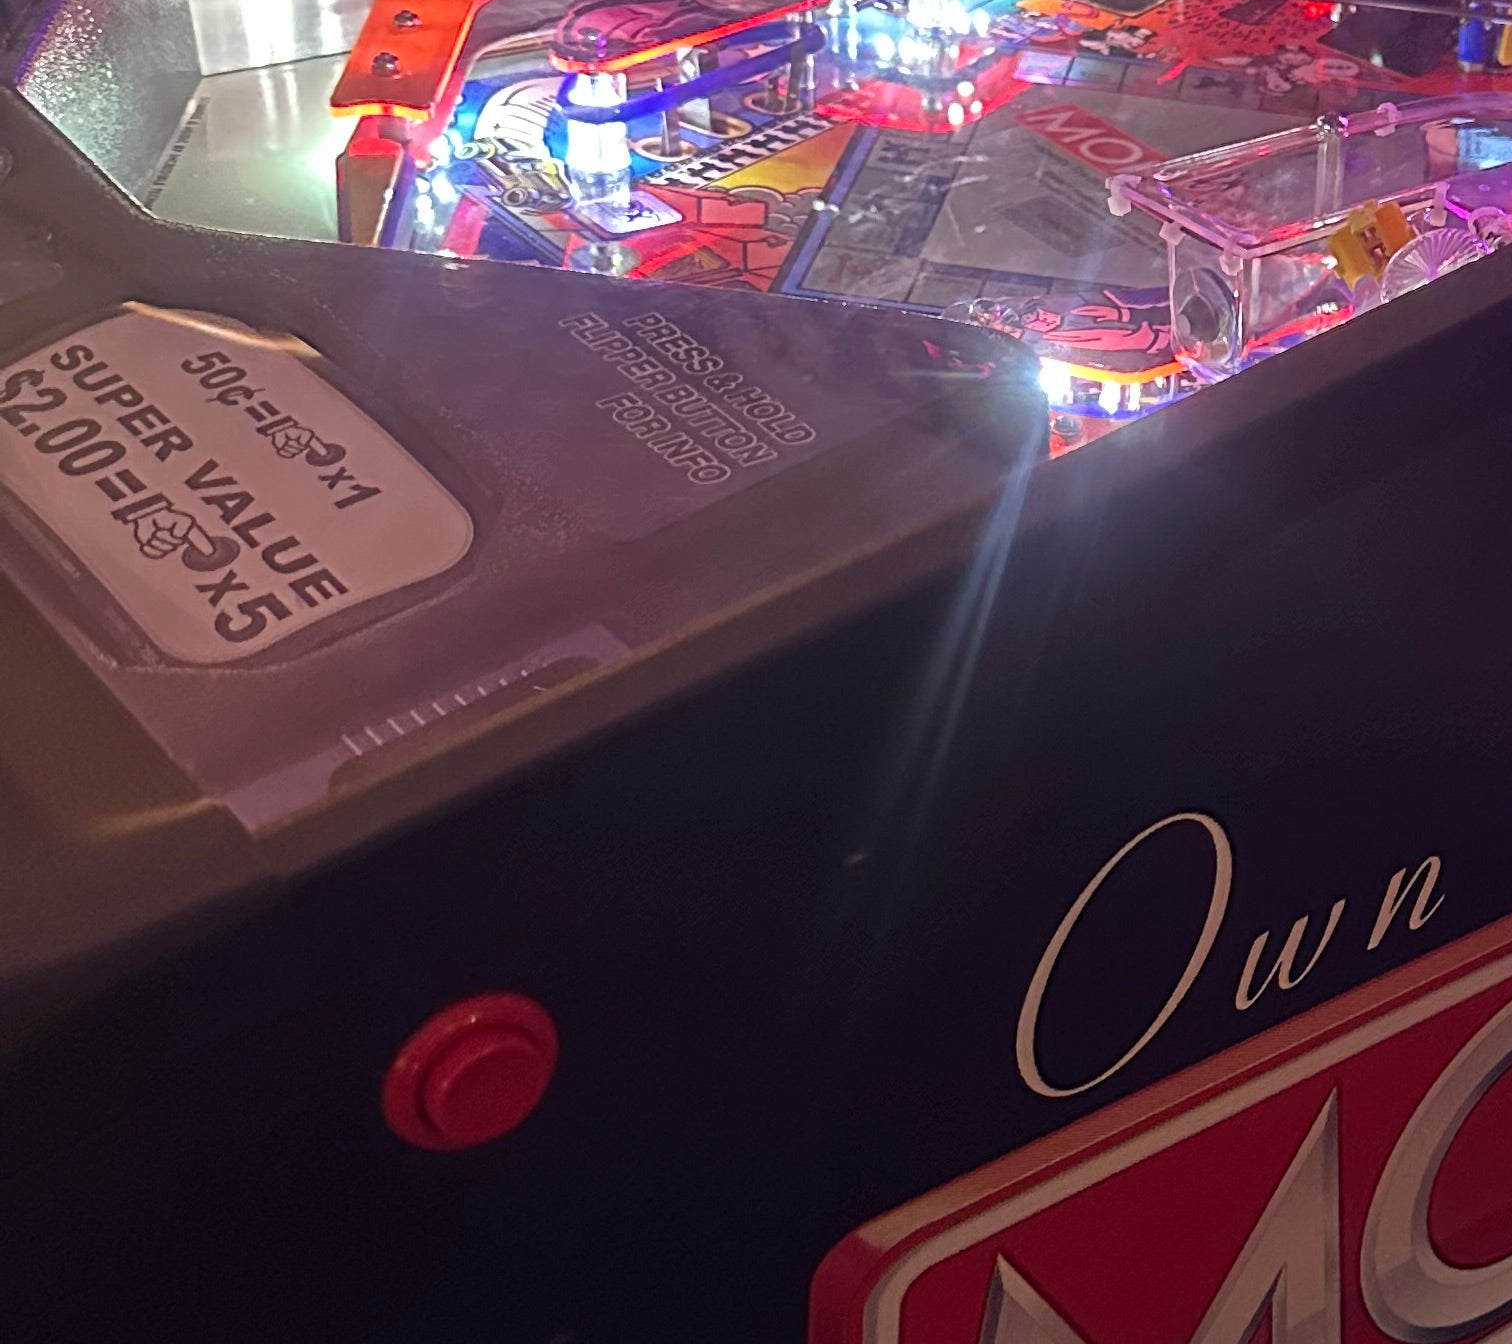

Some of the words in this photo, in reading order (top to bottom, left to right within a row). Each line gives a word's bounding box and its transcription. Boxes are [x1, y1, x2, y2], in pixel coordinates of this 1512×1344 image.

[557, 311, 677, 392] FLIPPER
[653, 384, 778, 468] BUTTON
[623, 311, 724, 375] PRESS
[702, 372, 744, 393] &
[595, 391, 672, 440] FOR
[647, 432, 732, 485] INFO
[722, 386, 817, 446] HOLD
[50, 343, 195, 463] SUPER
[183, 458, 350, 608] VALUE
[1015, 812, 1446, 1100] Own
